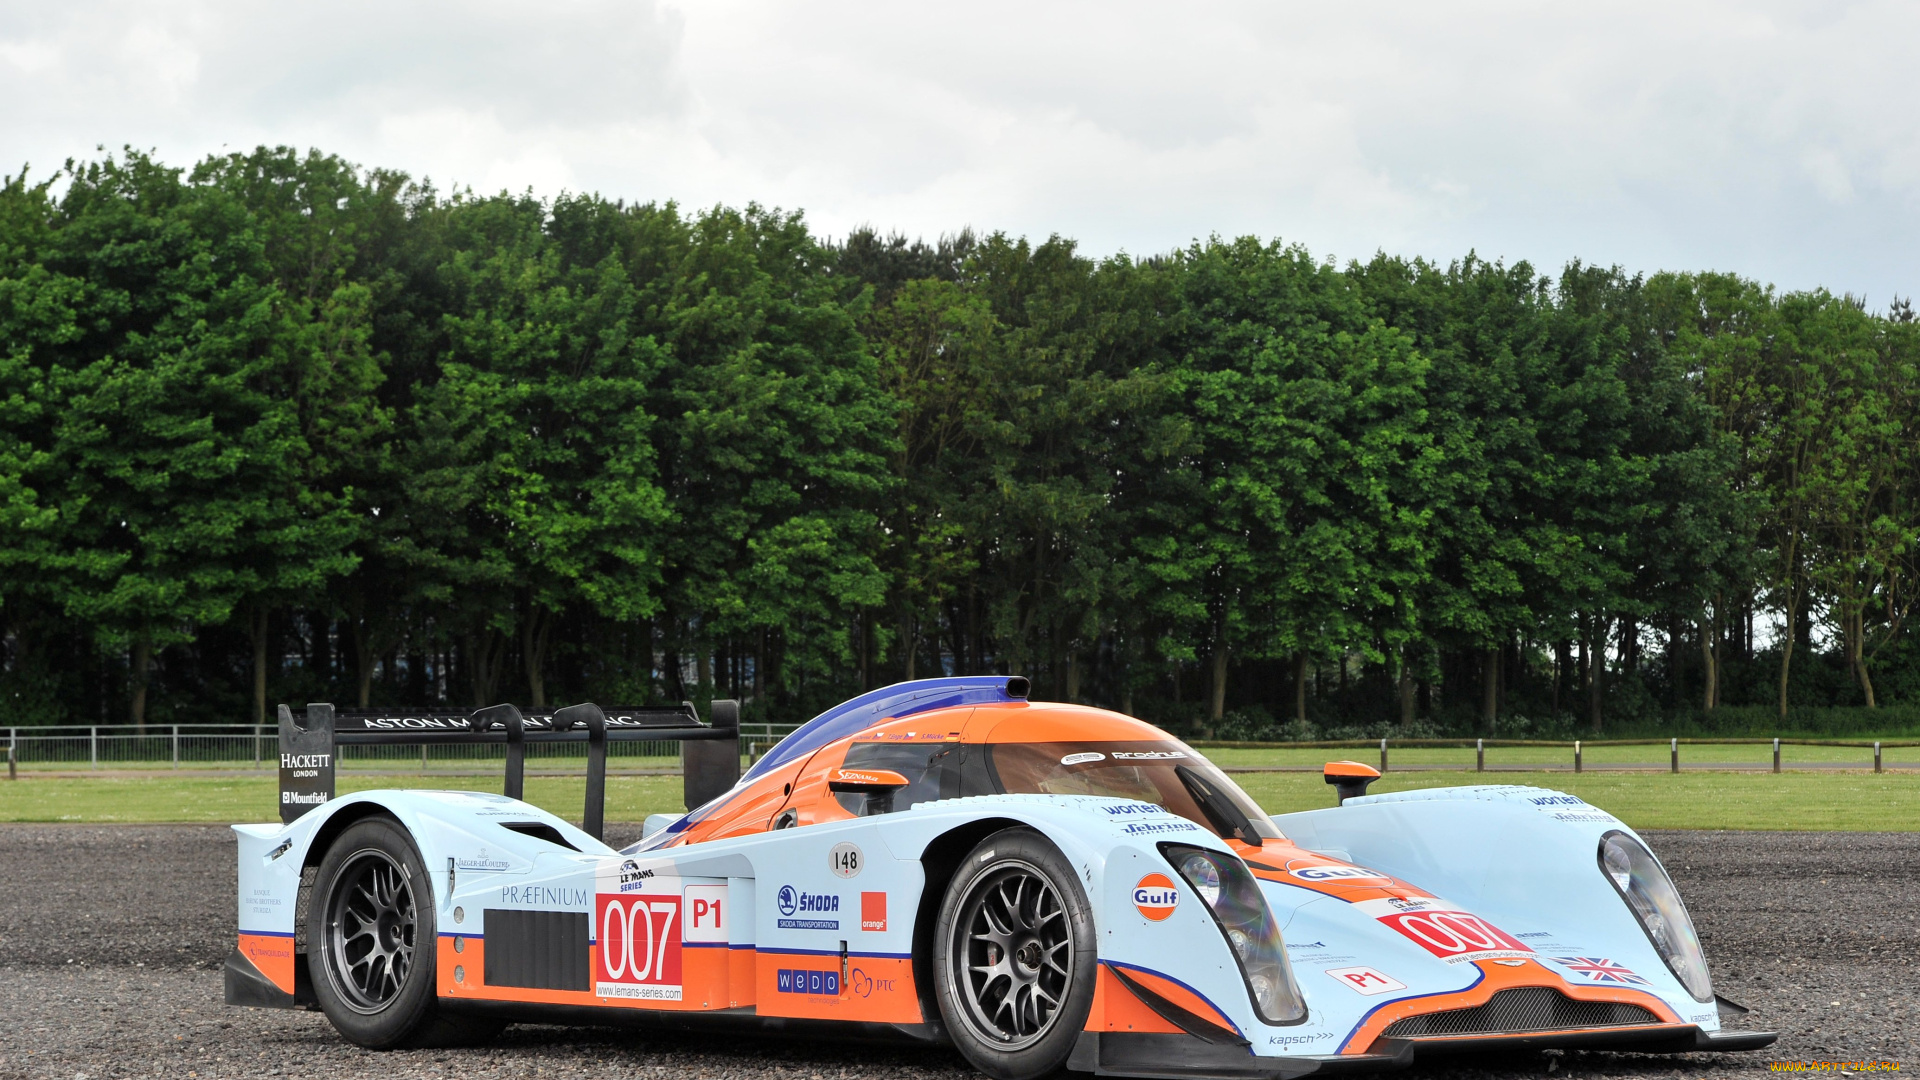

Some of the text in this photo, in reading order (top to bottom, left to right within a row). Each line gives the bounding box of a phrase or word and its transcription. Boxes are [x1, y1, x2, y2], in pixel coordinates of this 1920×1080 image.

[364, 718, 446, 729] ASTON
[281, 753, 330, 768] HACKETT
[293, 770, 318, 778] LONDON
[290, 791, 328, 804] Mountfield
[1527, 796, 1584, 805] worten
[1101, 804, 1166, 815] worten
[1120, 822, 1200, 834] Sebring
[835, 851, 858, 870] 148
[620, 869, 654, 883] LE MANS
[1297, 868, 1383, 879] Gulf
[620, 881, 643, 892] SERIES
[800, 892, 839, 911] ŠKODA
[1134, 889, 1177, 904] Gulf
[693, 898, 721, 928] P1
[797, 921, 837, 929] TRANSPORTATION
[1399, 913, 1513, 952] 007
[603, 899, 677, 981] 007
[877, 979, 894, 992] PTC
[1343, 972, 1388, 988] P1
[596, 985, 681, 999] www.lemans-series.com
[1269, 1035, 1314, 1046] kapsch
